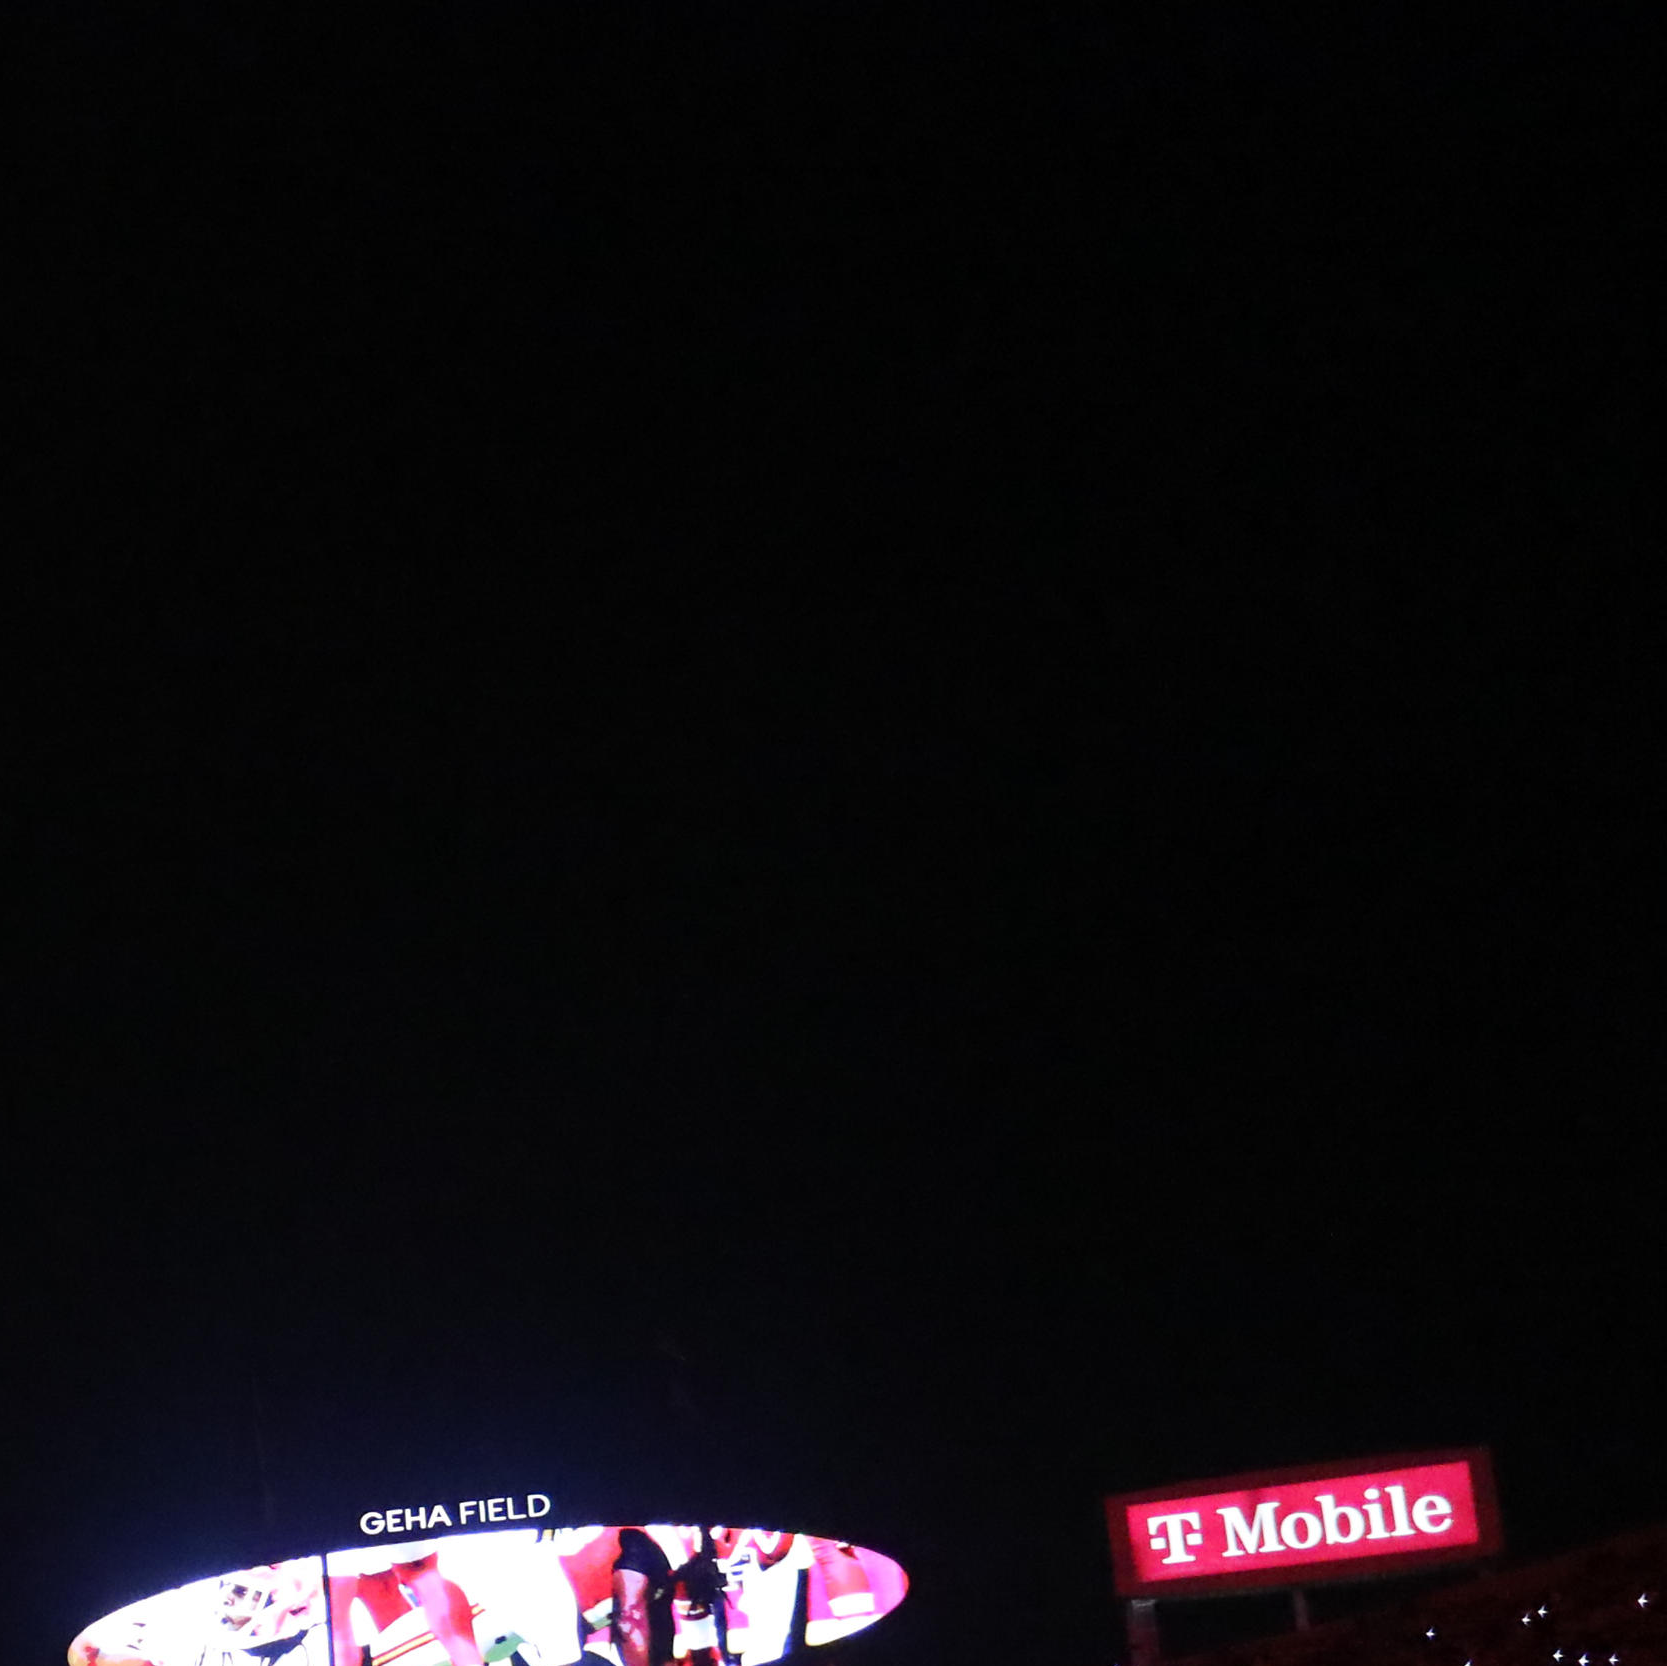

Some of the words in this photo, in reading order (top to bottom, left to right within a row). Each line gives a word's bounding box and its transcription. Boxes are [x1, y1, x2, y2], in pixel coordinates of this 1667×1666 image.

[360, 1505, 452, 1535] GEHA
[459, 1494, 551, 1525] FIELD
[1216, 1485, 1453, 1558] Mobile
